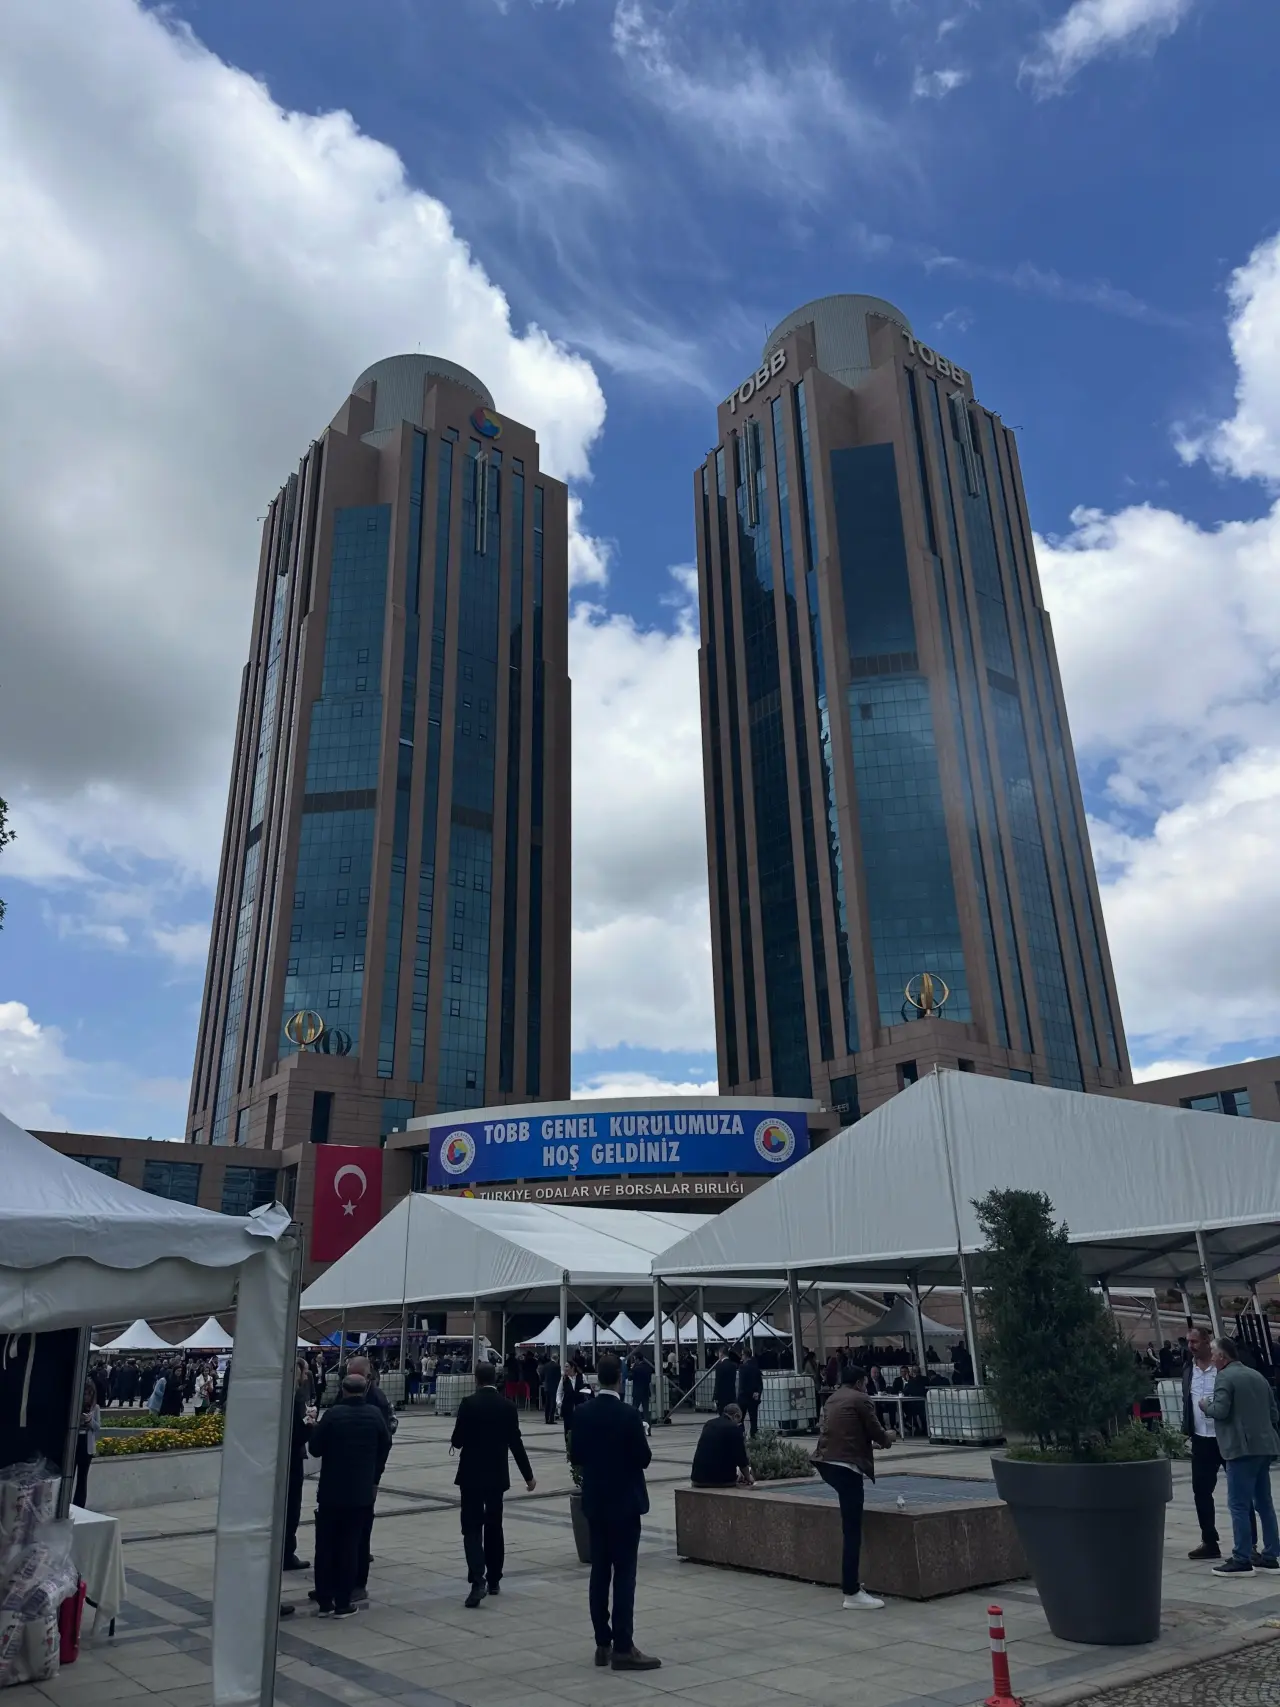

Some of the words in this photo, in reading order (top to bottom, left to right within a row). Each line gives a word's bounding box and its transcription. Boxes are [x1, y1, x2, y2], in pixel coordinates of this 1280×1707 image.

[902, 331, 966, 386] TOBB
[725, 348, 787, 415] TOBB
[484, 1121, 530, 1145] TOBB
[541, 1117, 598, 1140] GENEL
[609, 1114, 745, 1137] KURULUMUZA
[543, 1144, 580, 1172] HOŞ
[591, 1137, 680, 1165] GELDİNİZ
[535, 1186, 590, 1199] ODALAR
[594, 1185, 610, 1197] VE
[615, 1183, 690, 1196] BORSALAR
